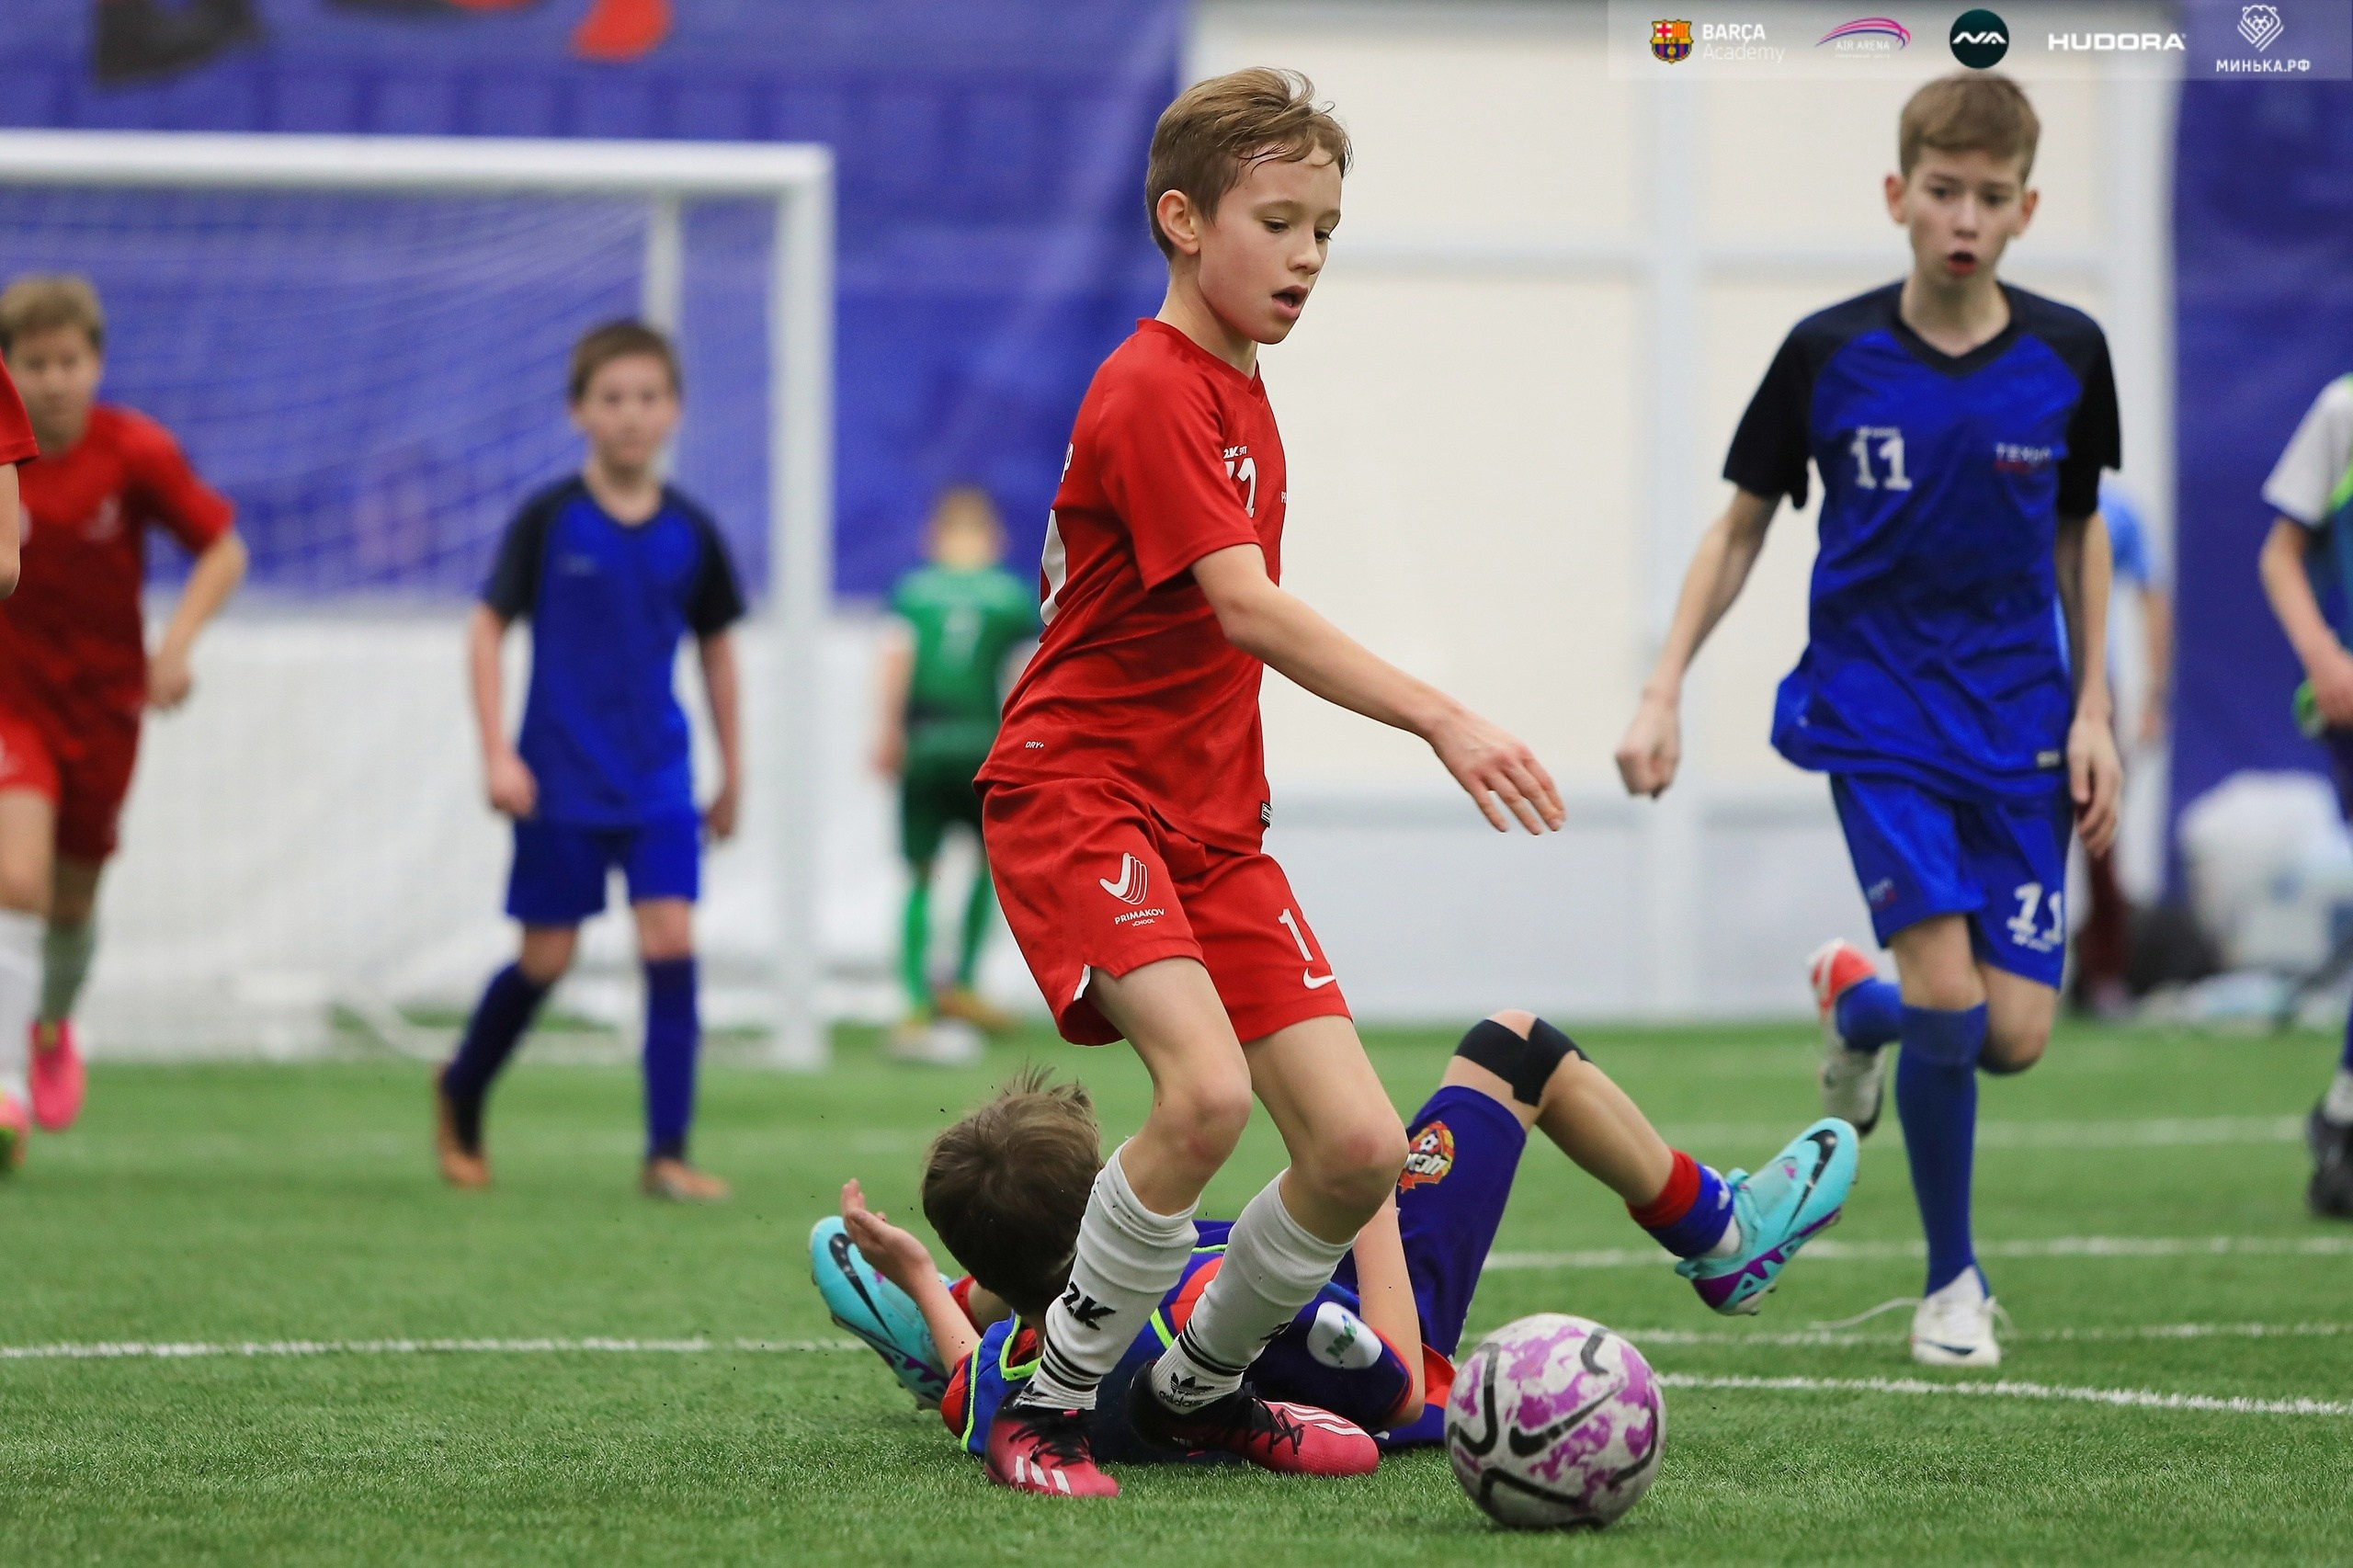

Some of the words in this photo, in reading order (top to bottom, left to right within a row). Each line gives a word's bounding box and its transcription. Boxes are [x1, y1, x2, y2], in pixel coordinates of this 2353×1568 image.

[1851, 437, 1913, 491] 11
[1114, 908, 1165, 925] PRIMAKOV
[1061, 1280, 1117, 1331] 2K
